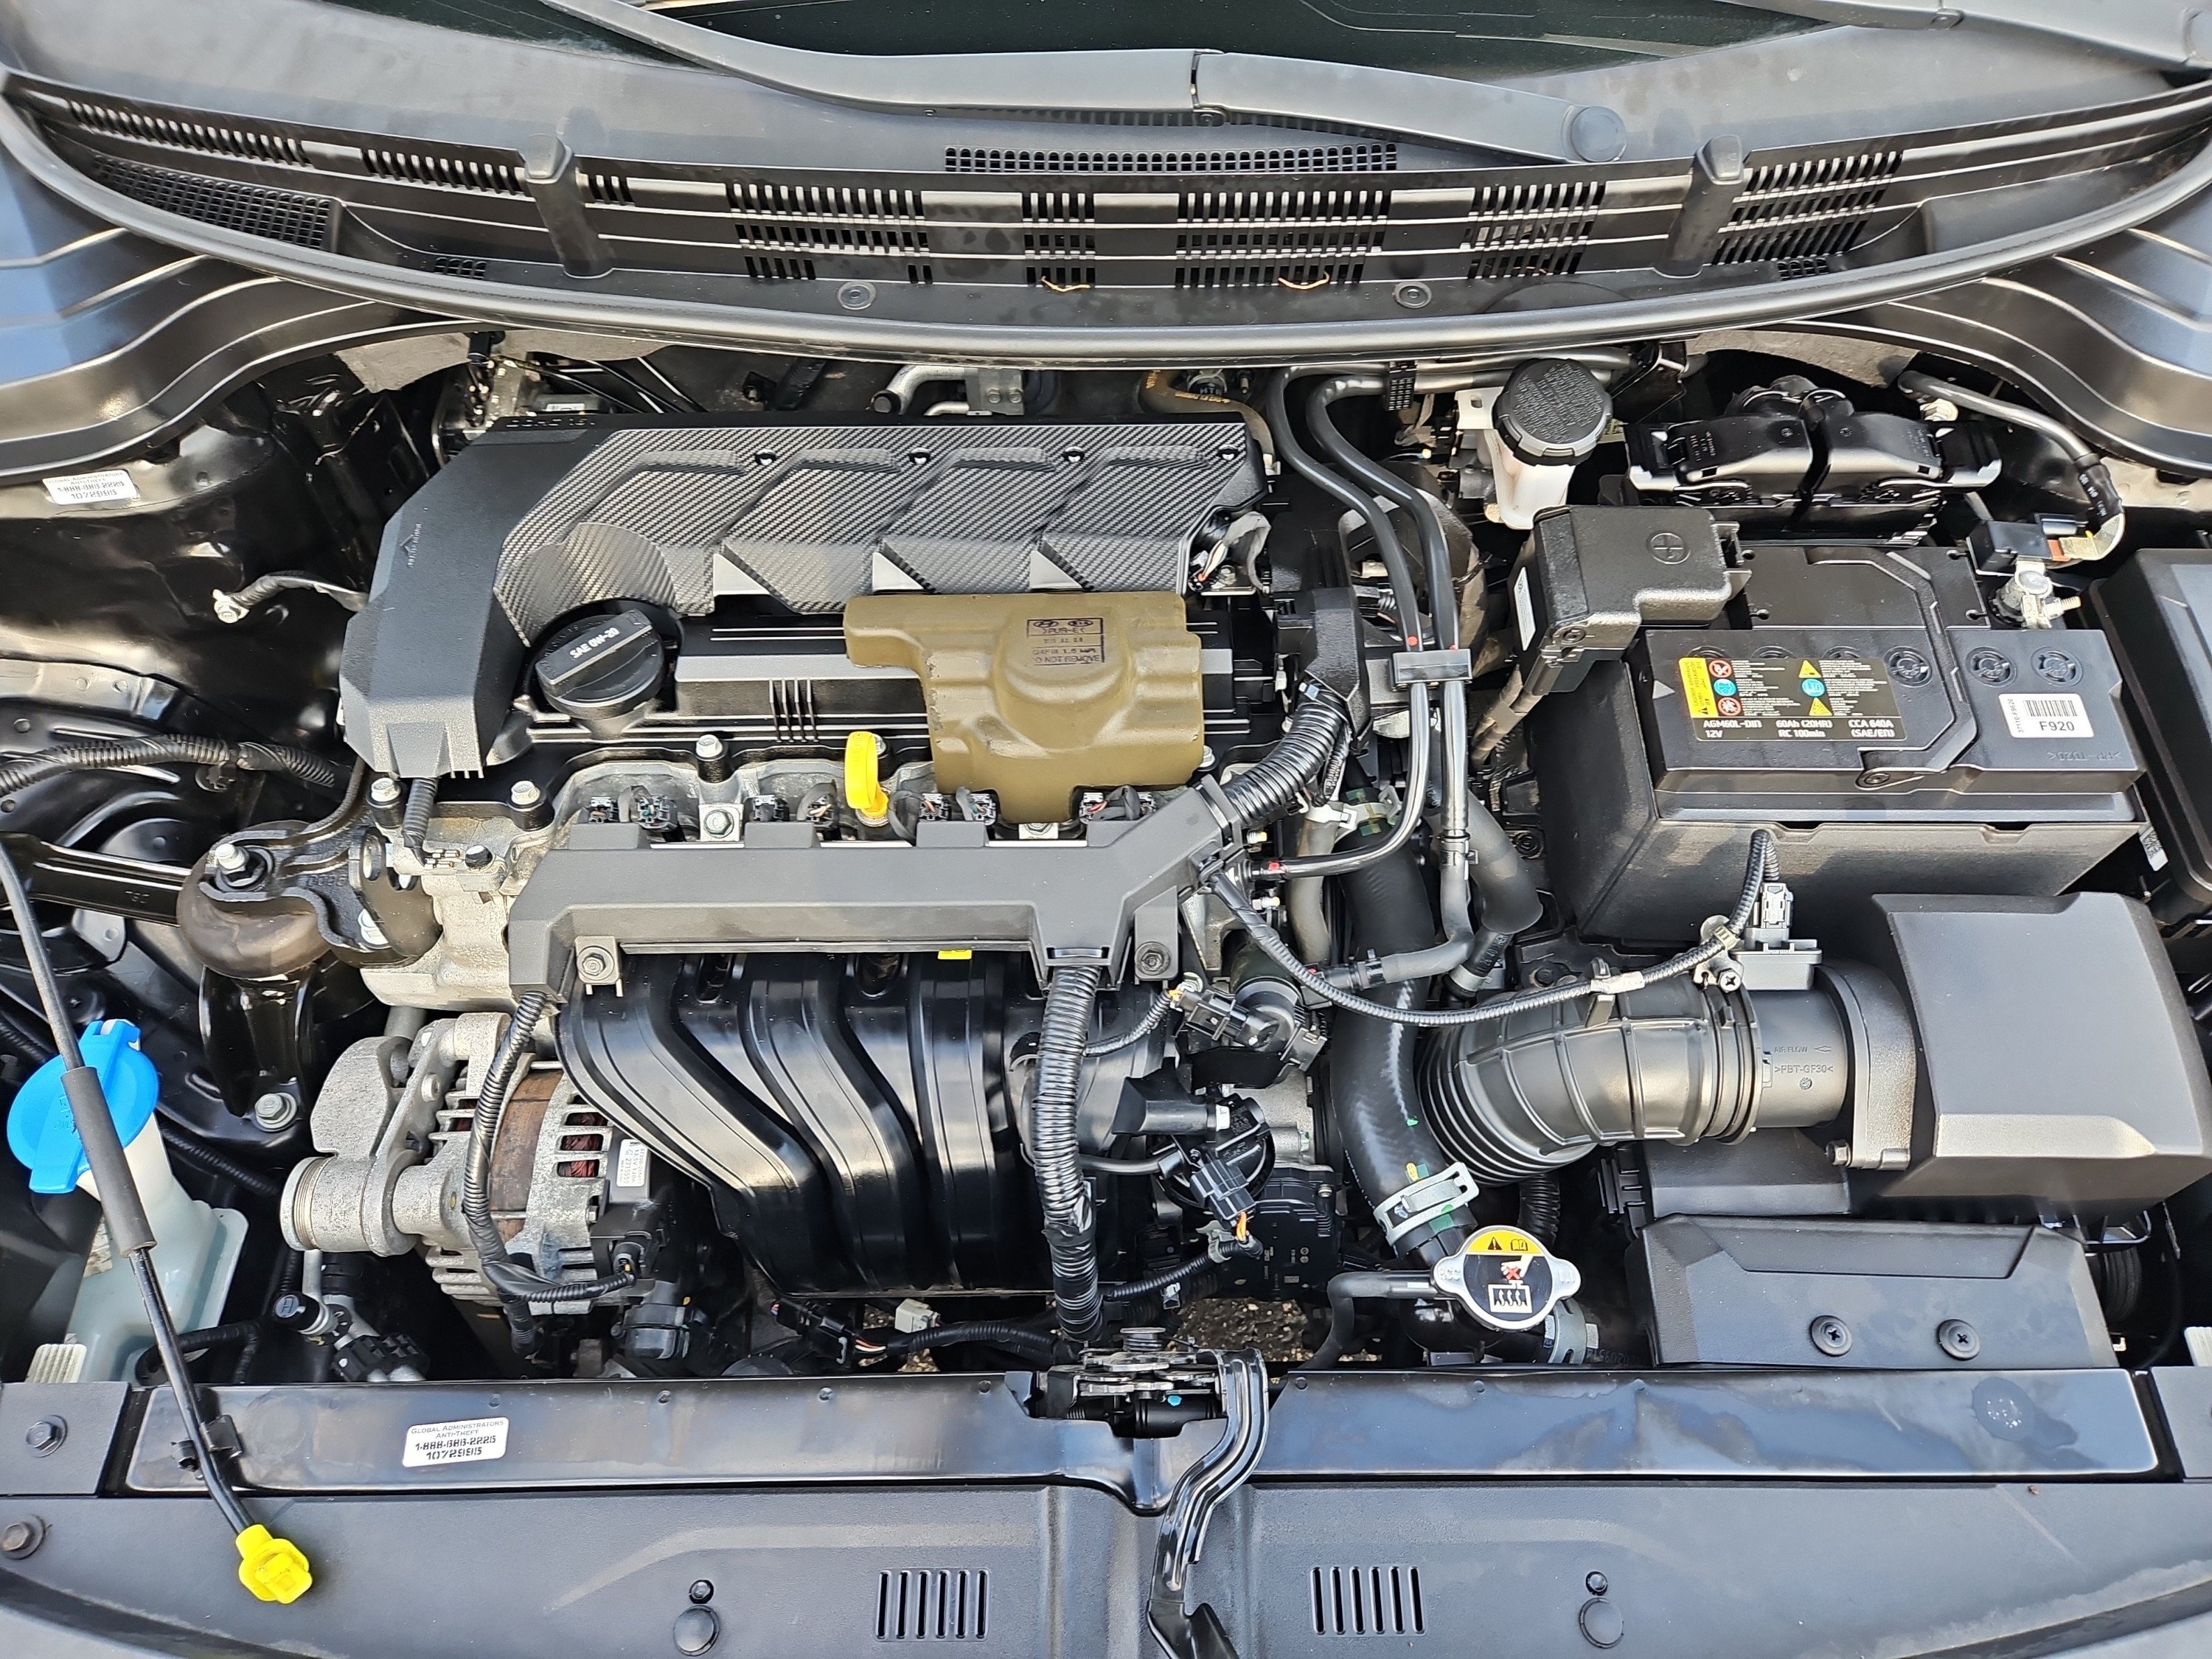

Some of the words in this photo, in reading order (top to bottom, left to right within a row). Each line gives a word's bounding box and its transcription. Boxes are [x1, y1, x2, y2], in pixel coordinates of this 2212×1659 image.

[569, 643, 592, 659] SAE
[588, 627, 620, 647] 0W-20
[1775, 720, 1800, 728] 60Ah
[1801, 720, 1833, 728] (20HR)
[1848, 720, 1868, 728] CCA
[2039, 721, 2075, 731] F920
[1704, 729, 1723, 738] 12V
[1778, 729, 1793, 737] RC
[1794, 729, 1826, 737] 100min
[442, 1420, 504, 1431] ADMINISTRATORS
[436, 1430, 479, 1439] ANTI-THEFT
